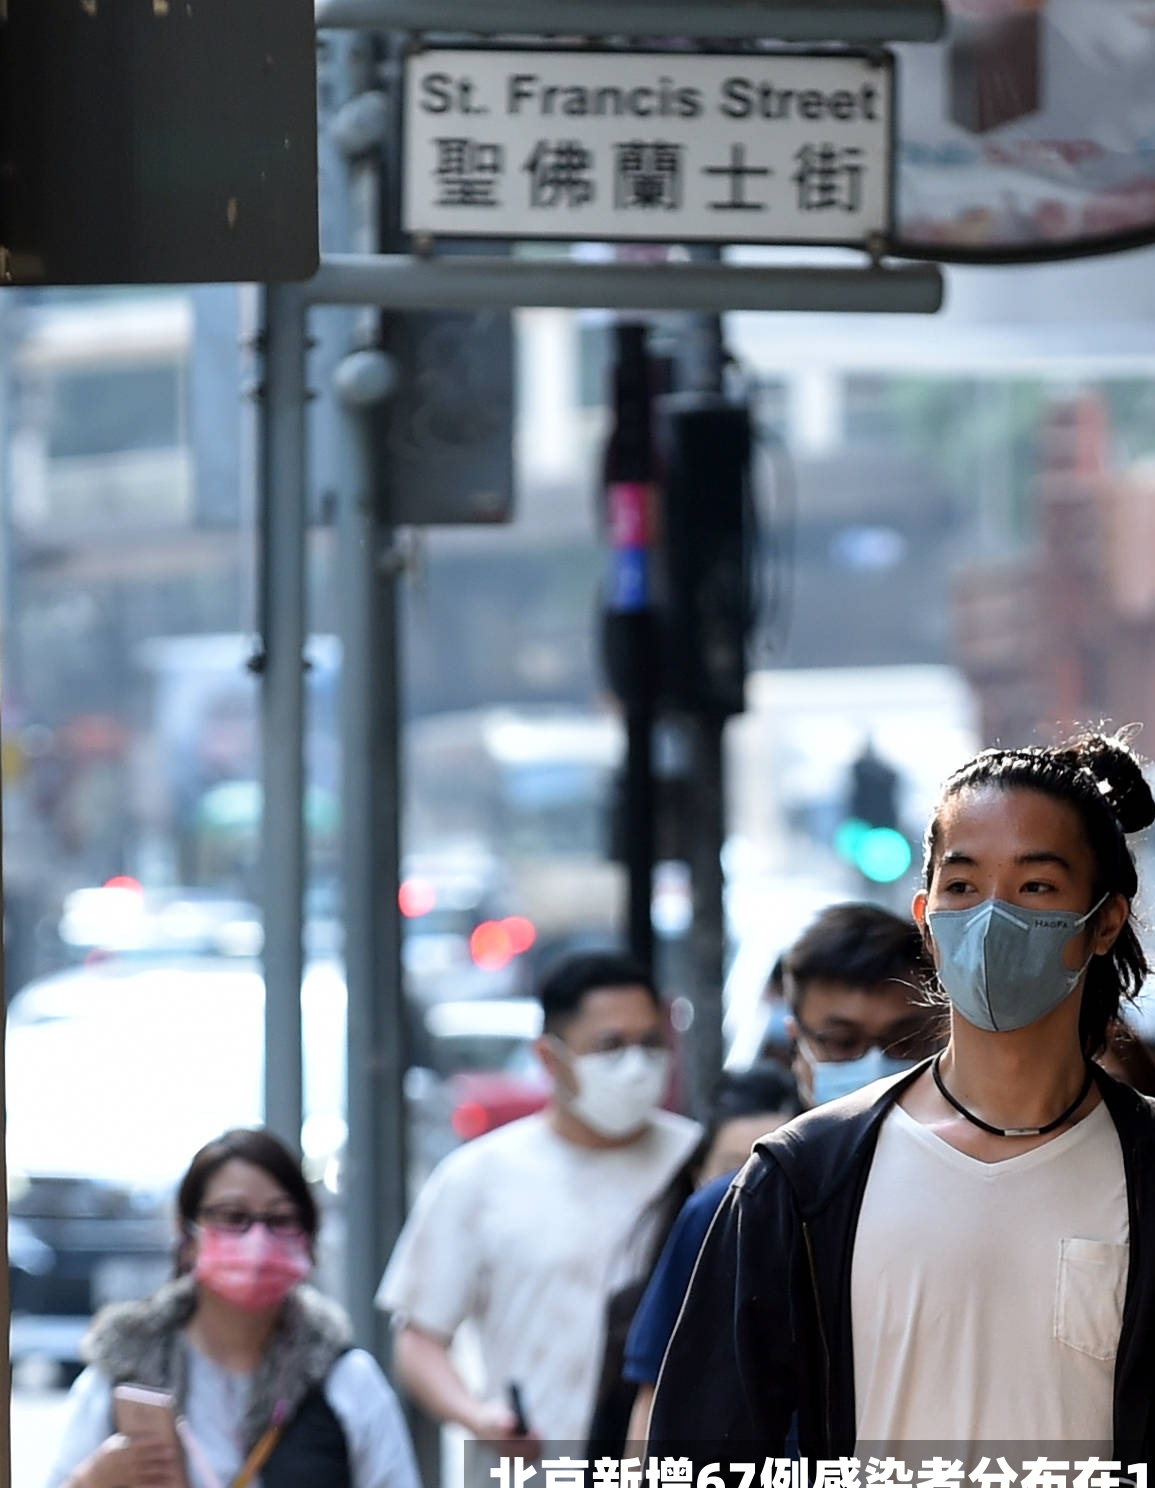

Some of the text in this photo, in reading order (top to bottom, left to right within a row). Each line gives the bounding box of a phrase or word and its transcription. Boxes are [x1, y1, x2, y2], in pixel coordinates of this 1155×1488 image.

[419, 73, 877, 121] St. Francis Street
[432, 138, 864, 212] 聖佛蘭士街
